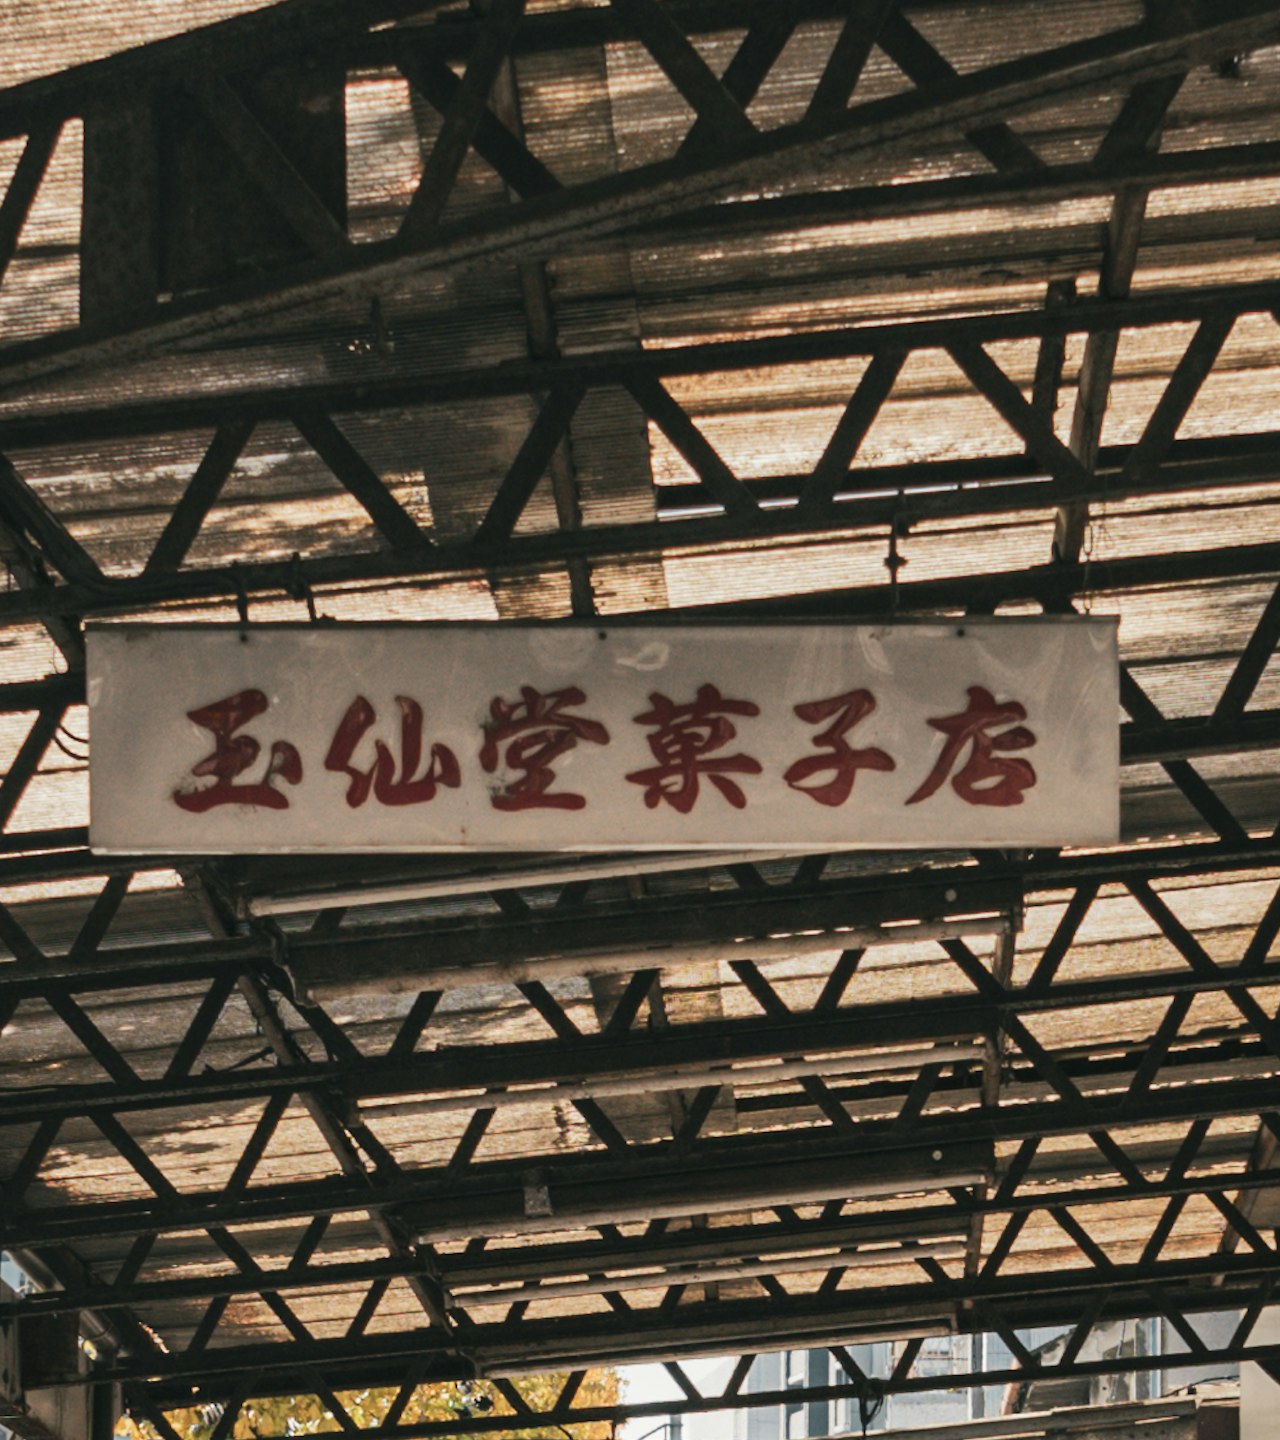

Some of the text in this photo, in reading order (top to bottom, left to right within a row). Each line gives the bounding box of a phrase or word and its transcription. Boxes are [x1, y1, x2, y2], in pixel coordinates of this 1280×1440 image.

[173, 683, 1039, 813] 玉仙堂菓子店
